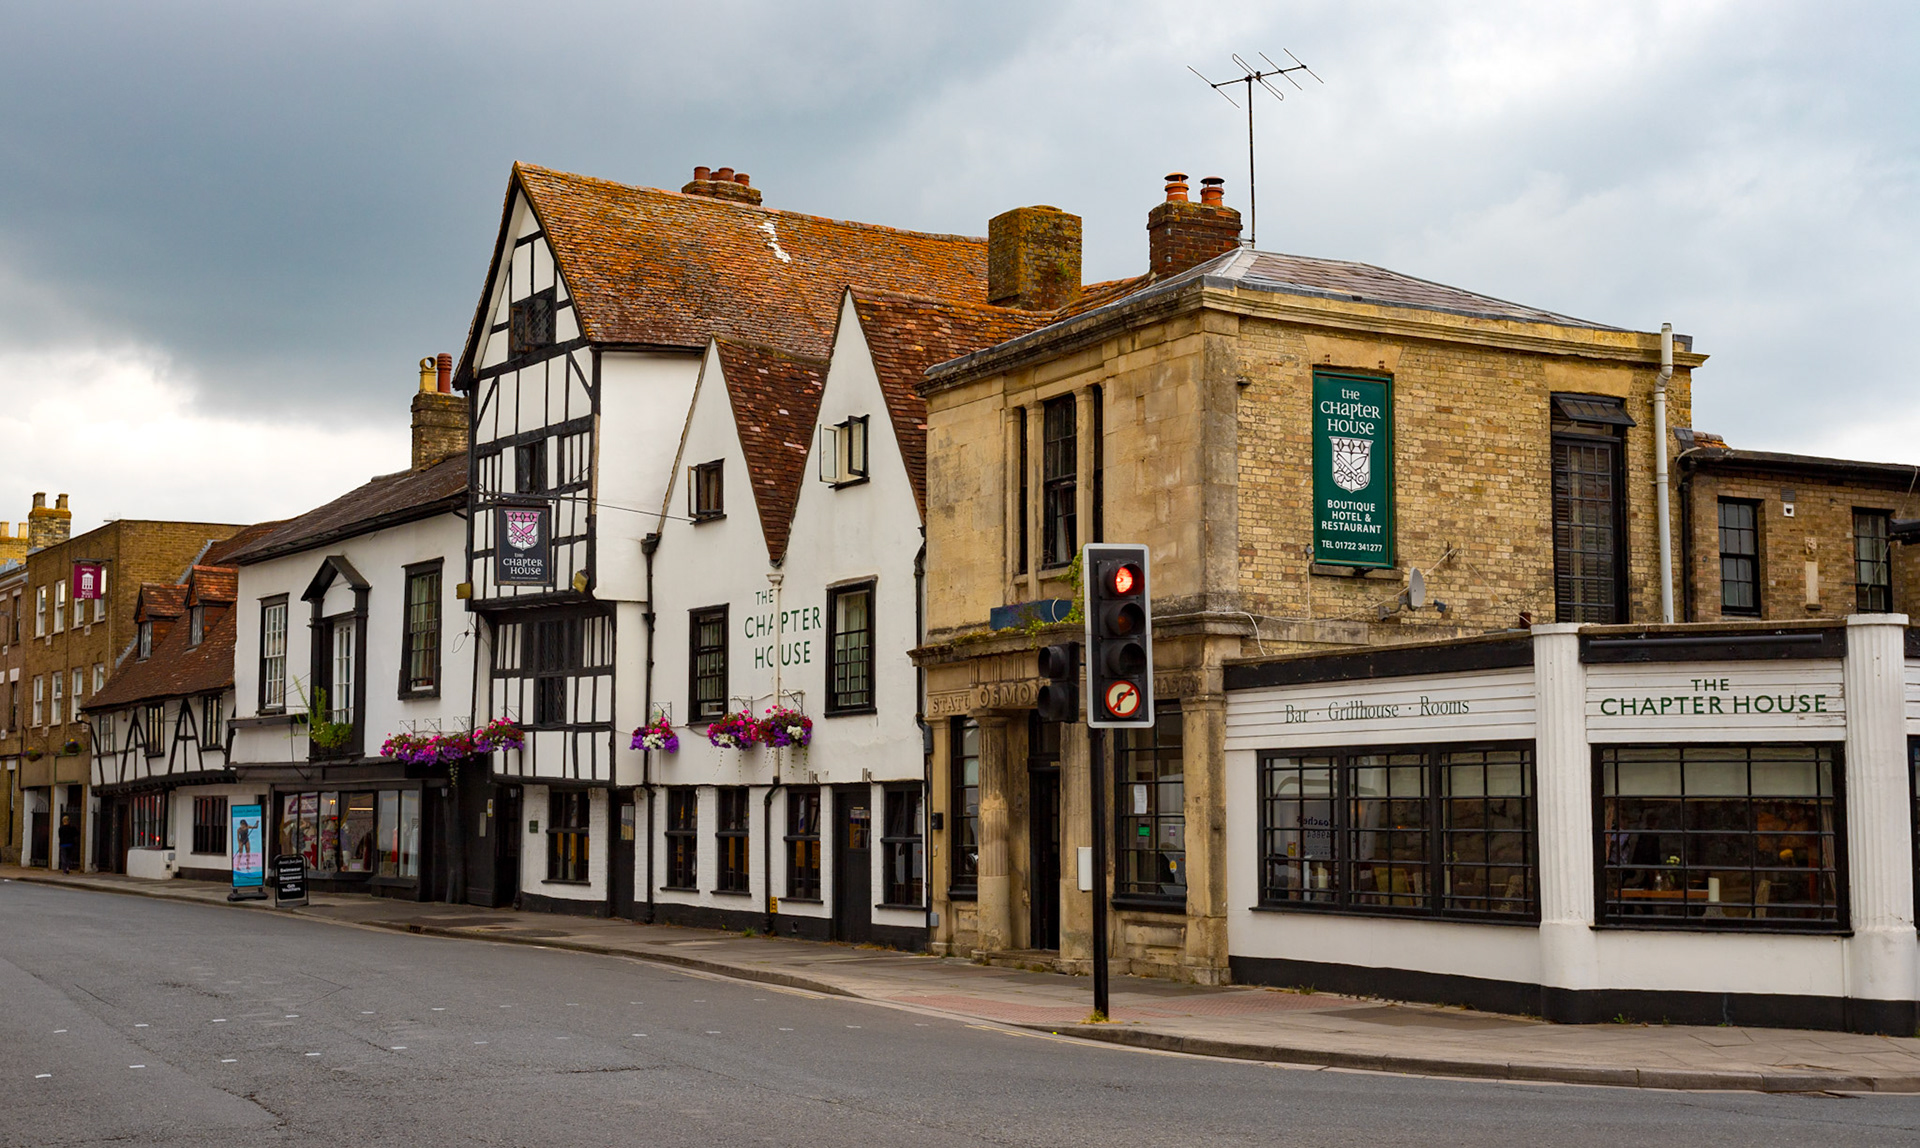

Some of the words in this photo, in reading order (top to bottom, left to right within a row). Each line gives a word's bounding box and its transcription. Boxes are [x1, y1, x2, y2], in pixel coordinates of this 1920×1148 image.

[1327, 499, 1376, 512] BOUTIQUE
[1332, 511, 1362, 522] HOTEL
[1364, 513, 1371, 523] &
[1321, 520, 1382, 534] RESTAURANT
[1321, 540, 1334, 549] TEL
[1335, 541, 1356, 551] 01722
[1357, 543, 1383, 552] 341277
[755, 589, 774, 605] THE
[1691, 678, 1730, 692] THE
[1285, 704, 1308, 724] Bar
[1328, 700, 1399, 721] Grillhouse
[1419, 695, 1470, 716] Rooms
[1600, 696, 1724, 716] CHAPTER
[1733, 694, 1828, 714] HOUSE
